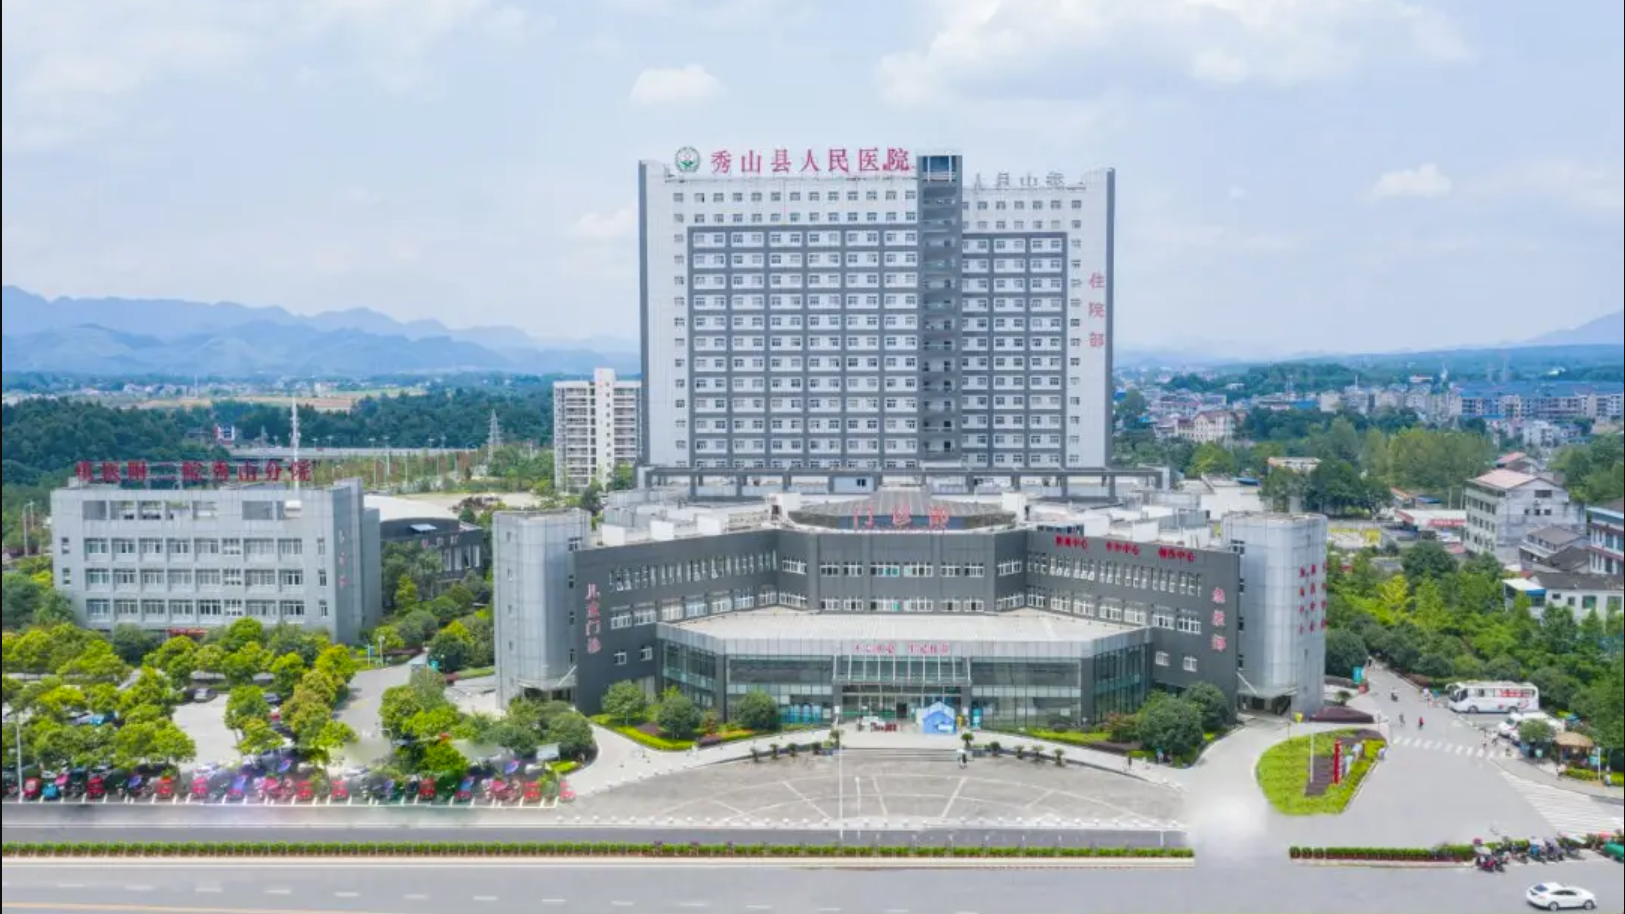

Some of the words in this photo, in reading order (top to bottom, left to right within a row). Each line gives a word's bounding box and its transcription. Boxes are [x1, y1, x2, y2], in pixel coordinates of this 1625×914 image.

[711, 148, 909, 174] 秀山县人民医院
[1089, 272, 1105, 348] 住院部
